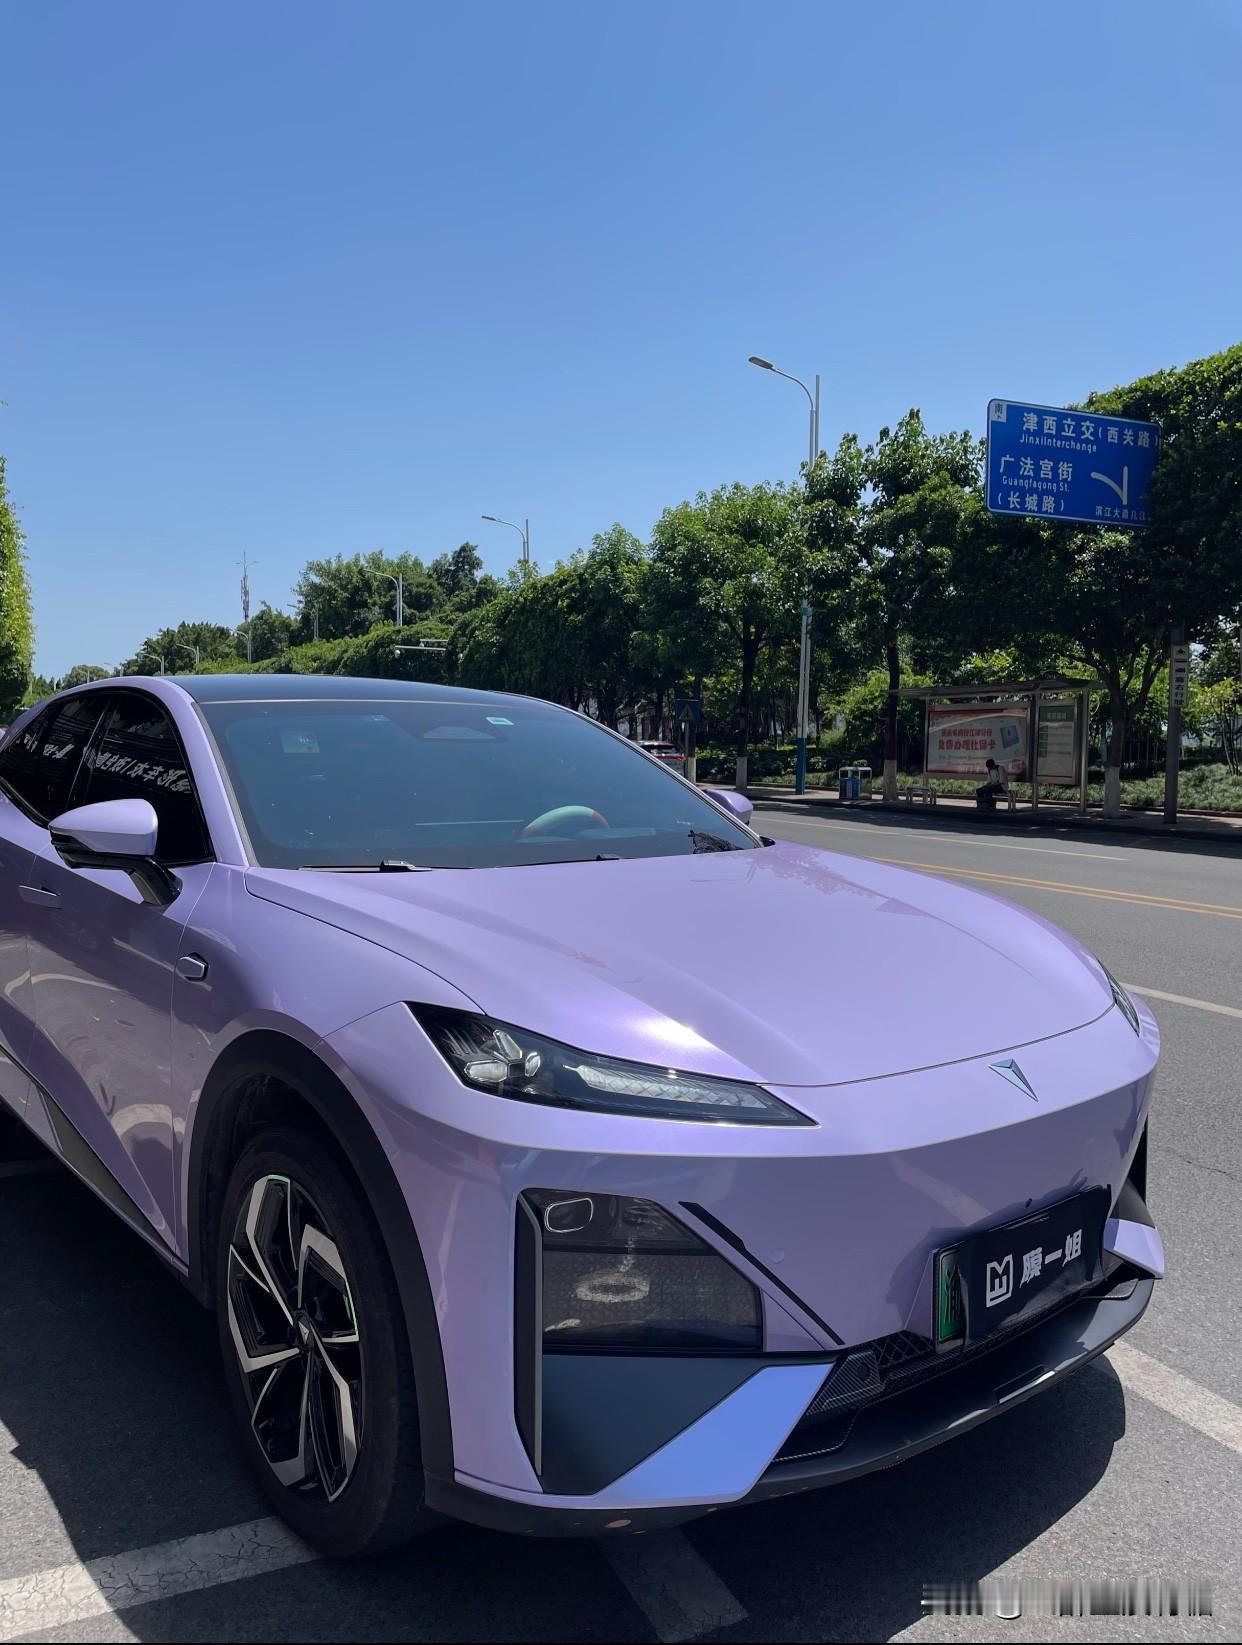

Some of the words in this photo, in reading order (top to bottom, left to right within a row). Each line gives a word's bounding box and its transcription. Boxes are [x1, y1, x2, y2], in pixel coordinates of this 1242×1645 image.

[1000, 454, 1073, 482] 广法宫街
[1002, 476, 1057, 493] Guangfagong
[1059, 481, 1070, 492] St.
[998, 490, 1064, 514] （长城路）
[937, 739, 997, 750] 免费办理社保卡
